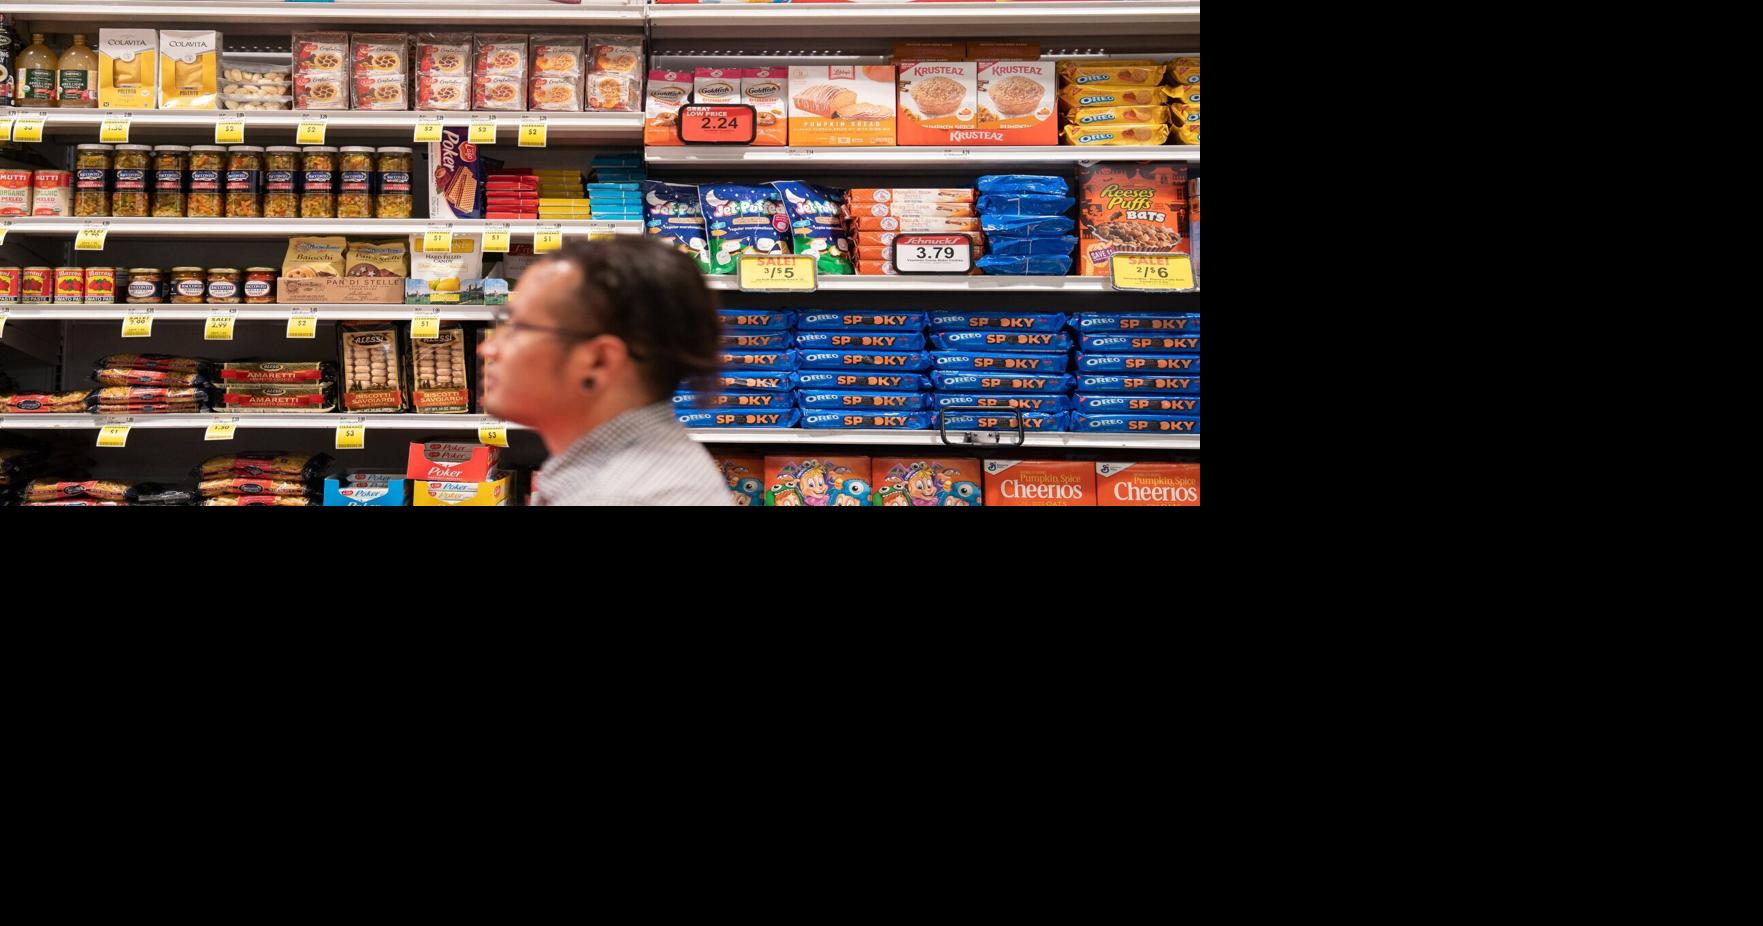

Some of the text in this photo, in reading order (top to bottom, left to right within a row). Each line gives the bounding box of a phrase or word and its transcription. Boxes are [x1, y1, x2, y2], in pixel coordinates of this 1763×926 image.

[914, 66, 964, 76] KRUSTEAZ
[992, 65, 1042, 75] KRUSTEAZ
[1076, 75, 1109, 84] OREO
[1080, 95, 1114, 104] OREO
[702, 117, 738, 129] 2.24
[1081, 114, 1114, 123] OREO
[950, 130, 1004, 142] KRUSTEAZ
[1079, 133, 1113, 143] OREO
[442, 130, 459, 171] Poker
[916, 247, 955, 259] 3.79
[757, 256, 796, 266] SALE!
[1128, 256, 1170, 265] SALE!
[806, 314, 839, 322] OREO
[933, 316, 965, 324] OREO
[1080, 318, 1114, 326] OREO
[355, 335, 384, 343] ALESSI
[797, 334, 827, 342] OREO
[949, 332, 982, 341] OREO
[1092, 337, 1126, 346] OREO
[806, 353, 839, 361] OREO
[936, 356, 969, 364] OREO
[1086, 357, 1120, 366] OREO
[800, 374, 833, 382] OREO
[943, 376, 977, 385] OREO
[1084, 377, 1118, 385] OREO
[805, 394, 838, 402] OREO
[940, 397, 973, 405] OREO
[1090, 399, 1124, 407] OREO
[680, 414, 711, 423] OREO
[806, 414, 839, 423] OREO
[1089, 419, 1123, 427] OREO
[441, 451, 465, 459] Poker
[427, 467, 463, 477] Poker
[1020, 473, 1081, 484] Pumpkin Spice
[1134, 475, 1196, 486] Pumpkin Spice
[442, 483, 469, 491] Poker
[1000, 479, 1083, 499] Cheerios
[1114, 481, 1198, 501] Cheerios
[355, 489, 380, 497] Poker
